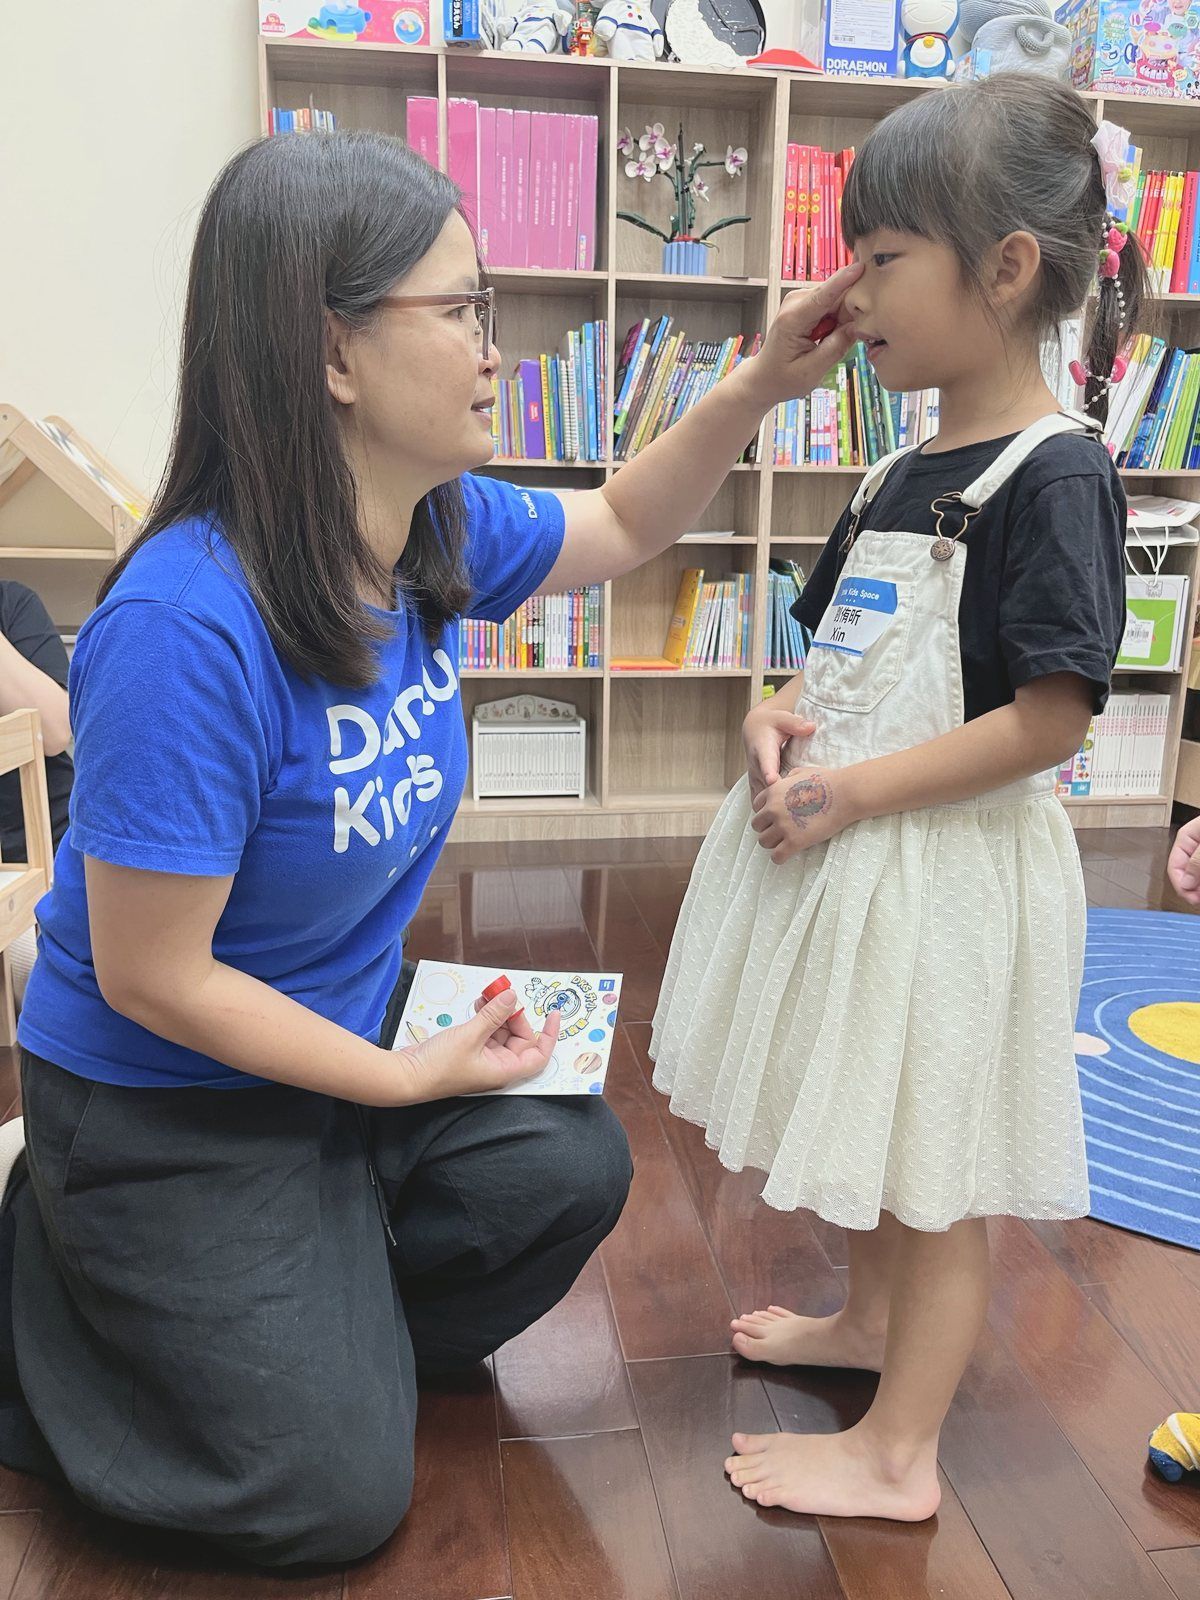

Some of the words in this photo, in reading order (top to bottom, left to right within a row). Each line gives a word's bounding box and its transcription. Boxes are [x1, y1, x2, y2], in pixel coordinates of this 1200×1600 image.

[826, 58, 887, 73] DORAEMON
[859, 589, 880, 600] Space
[829, 626, 846, 643] Xin
[333, 754, 443, 854] Kids
[571, 975, 592, 993] DKS
